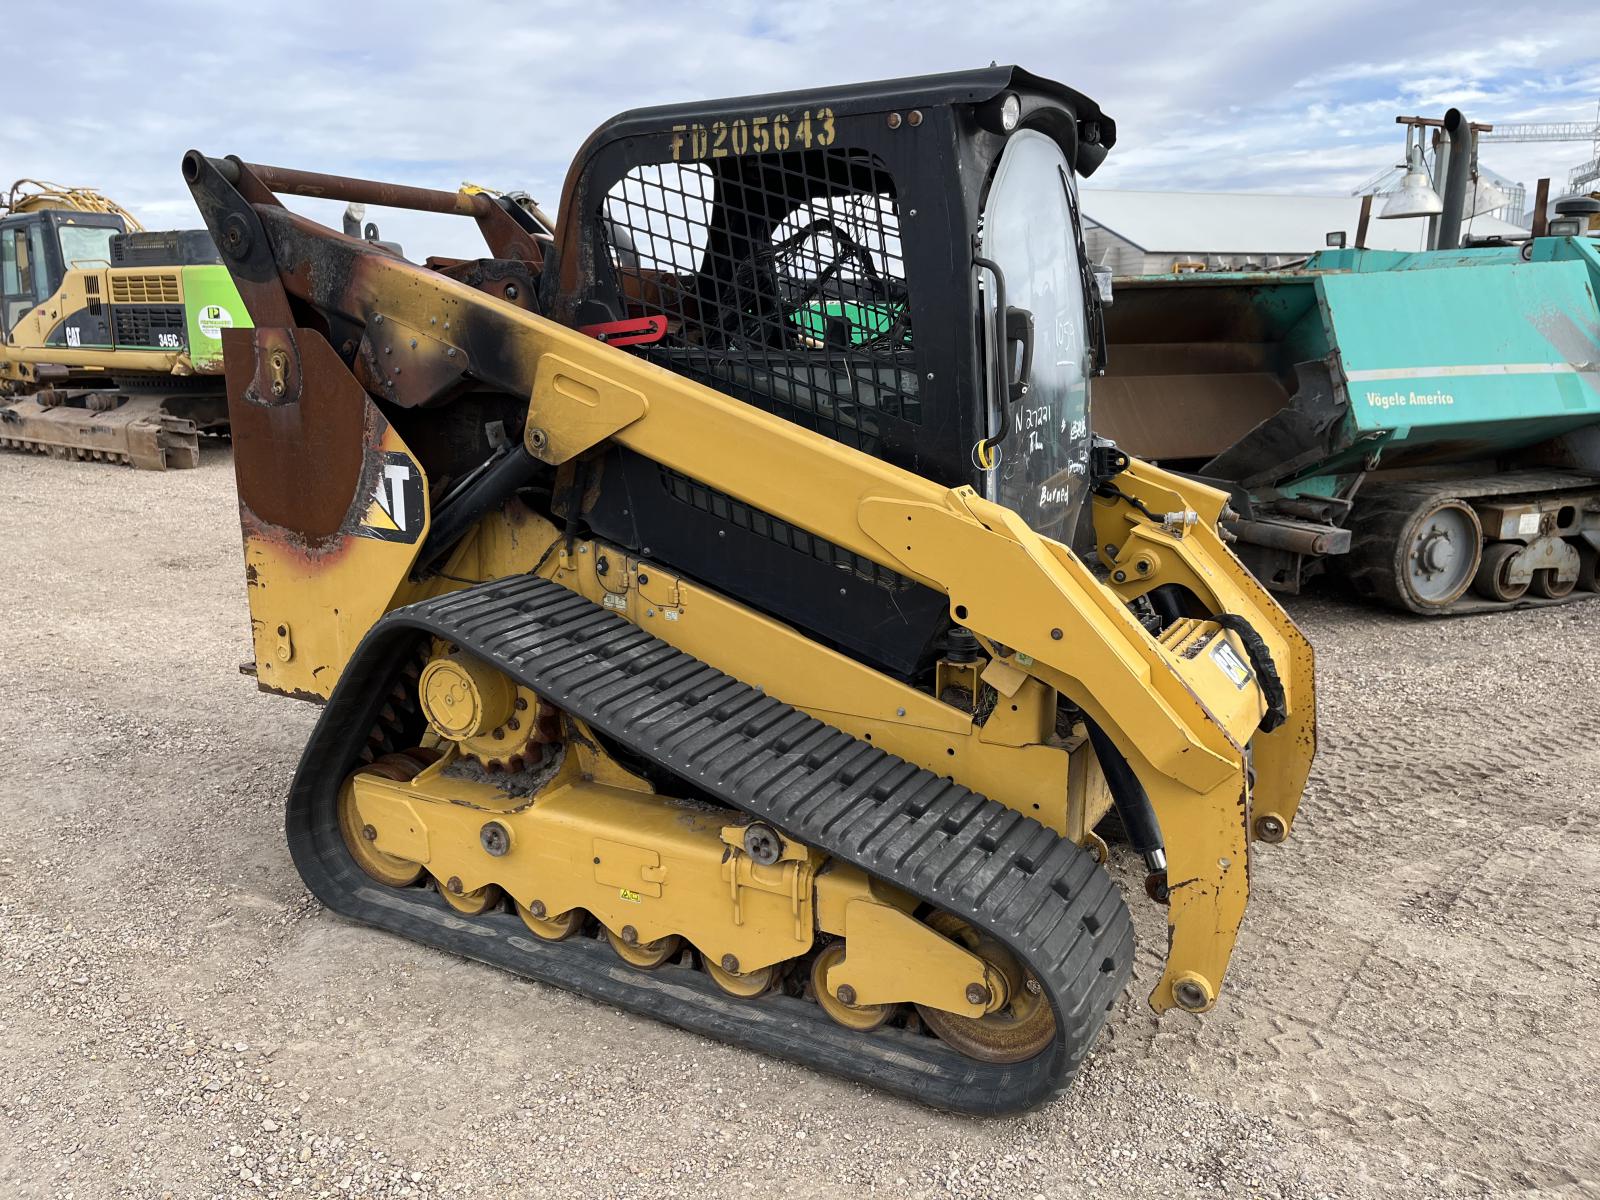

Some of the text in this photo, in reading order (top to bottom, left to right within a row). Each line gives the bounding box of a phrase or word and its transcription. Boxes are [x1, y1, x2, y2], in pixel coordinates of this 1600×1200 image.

[671, 107, 836, 160] FD205643
[66, 326, 80, 347] CAT
[158, 333, 179, 347] 345C
[1366, 390, 1454, 409] Vögele America
[1040, 484, 1069, 508] Burned
